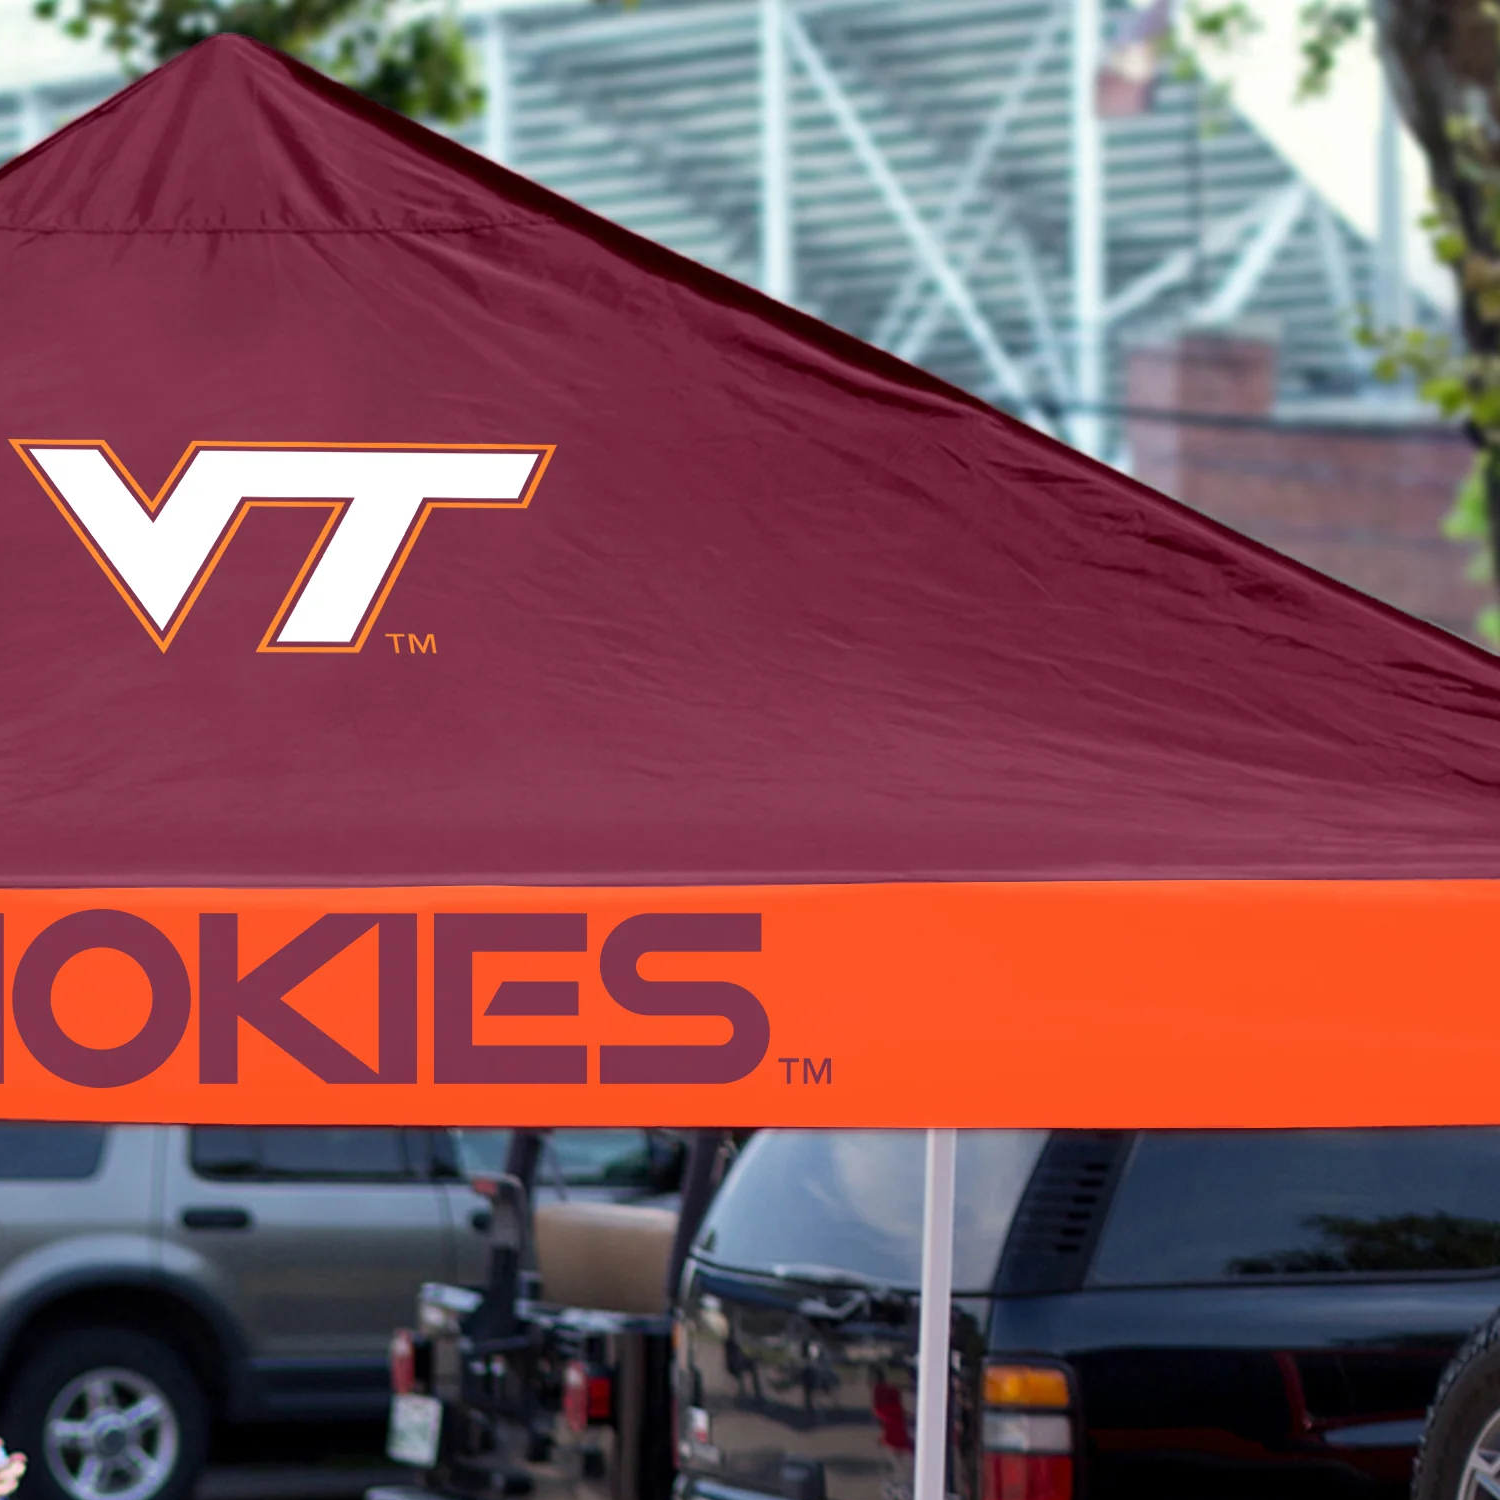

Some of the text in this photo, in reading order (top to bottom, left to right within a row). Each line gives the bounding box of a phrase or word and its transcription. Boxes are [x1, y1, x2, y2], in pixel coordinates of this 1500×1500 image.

[8, 438, 558, 654] VT TM
[777, 1057, 832, 1085] TM
